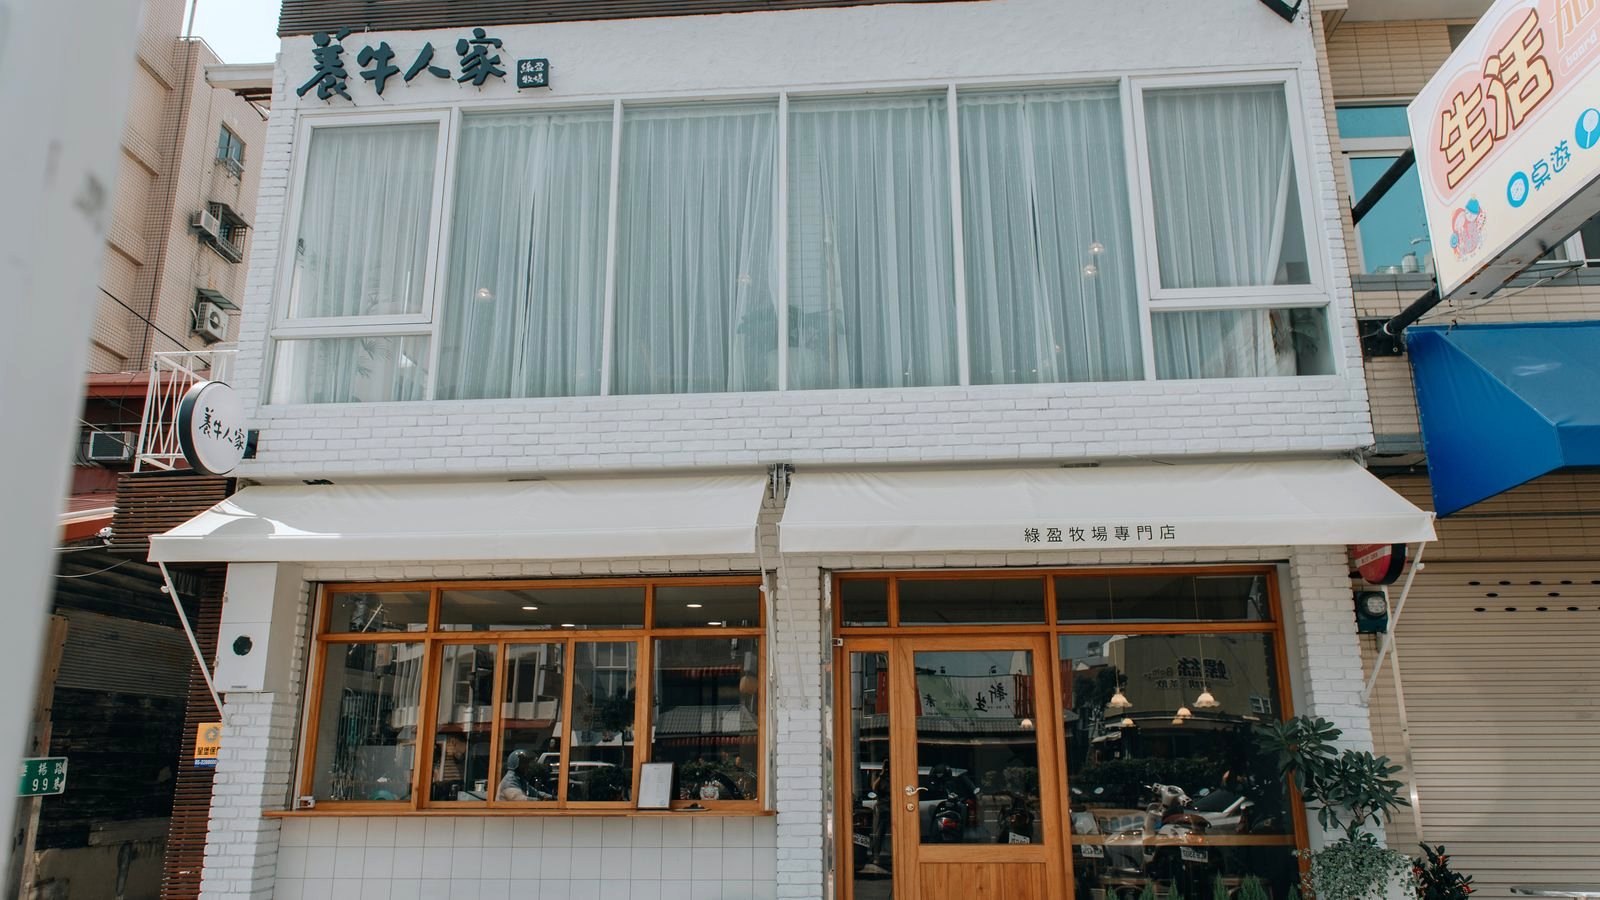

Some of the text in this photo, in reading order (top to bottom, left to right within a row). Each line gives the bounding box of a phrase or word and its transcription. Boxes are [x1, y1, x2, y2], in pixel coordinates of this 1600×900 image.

[296, 26, 507, 101] 養牛人家
[1440, 8, 1554, 189] 生活
[1531, 140, 1571, 191] 桌遊
[199, 406, 245, 450] 養牛人家
[1024, 524, 1175, 543] 綠盈牧場專門店
